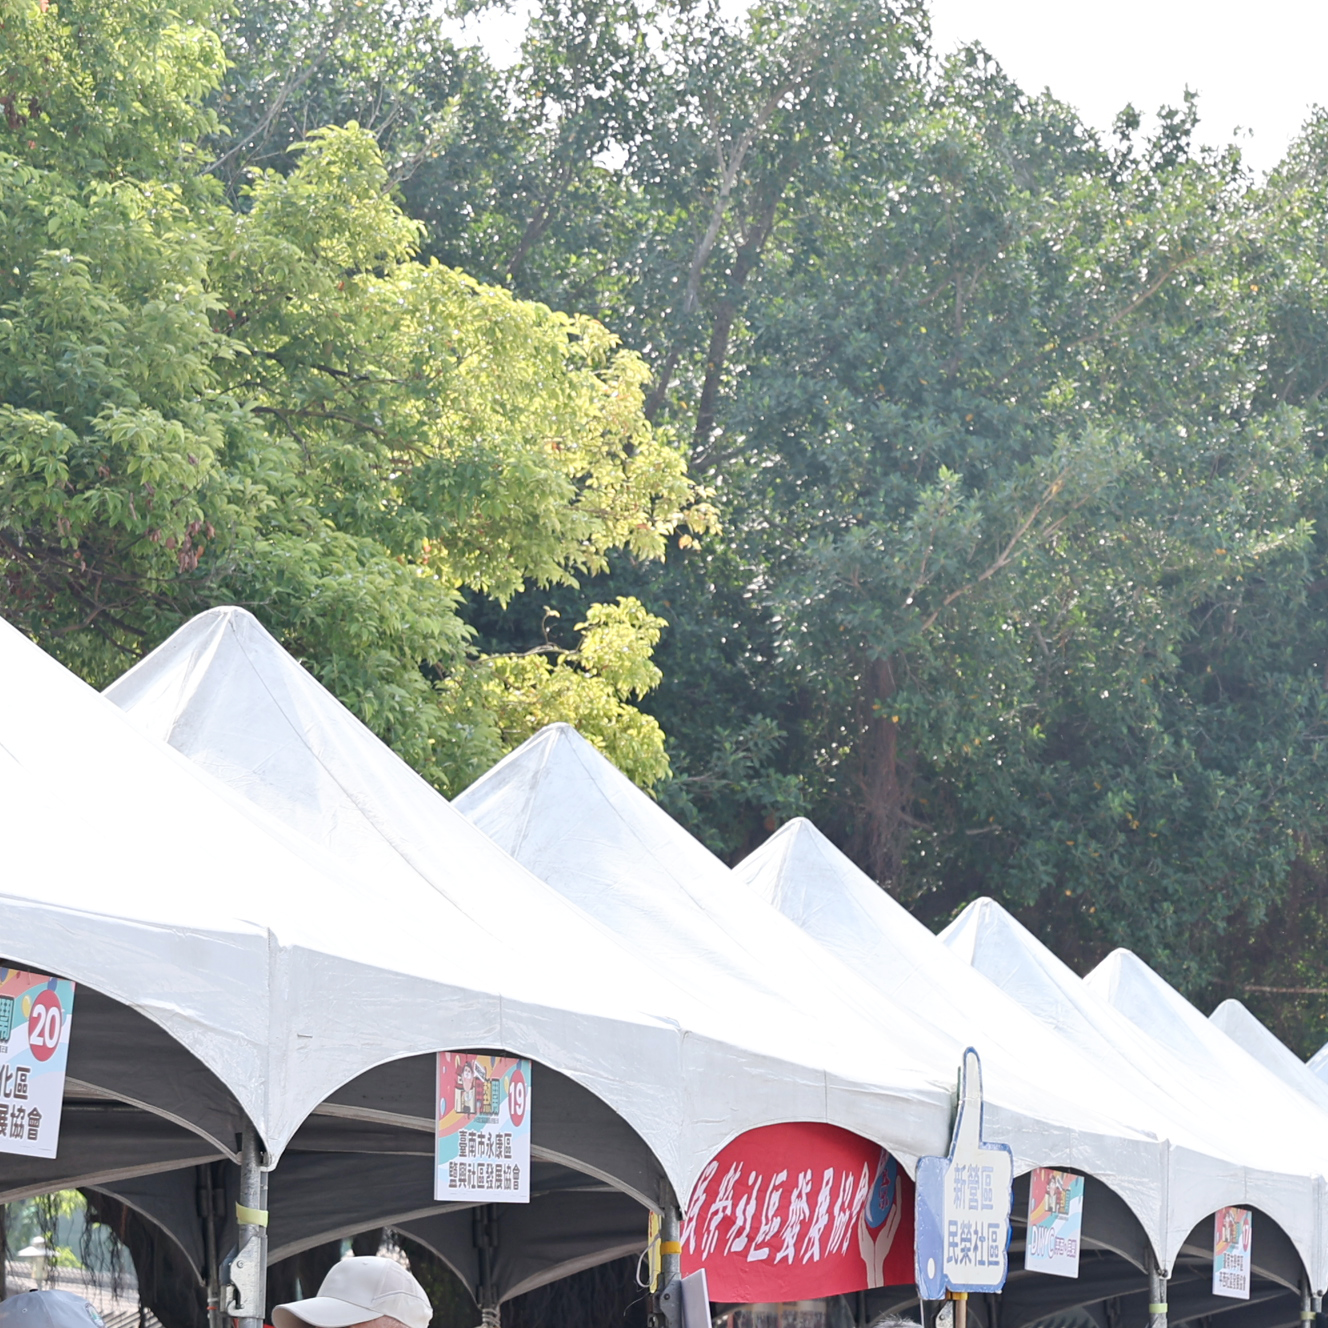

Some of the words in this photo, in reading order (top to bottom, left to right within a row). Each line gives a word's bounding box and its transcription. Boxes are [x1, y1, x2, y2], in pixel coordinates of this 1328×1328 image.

[30, 1003, 57, 1049] 20
[509, 1081, 525, 1116] 19
[458, 1130, 513, 1159] 臺南市永康區
[953, 1163, 994, 1212] 新營區
[946, 1219, 1001, 1267] 民榮社區
